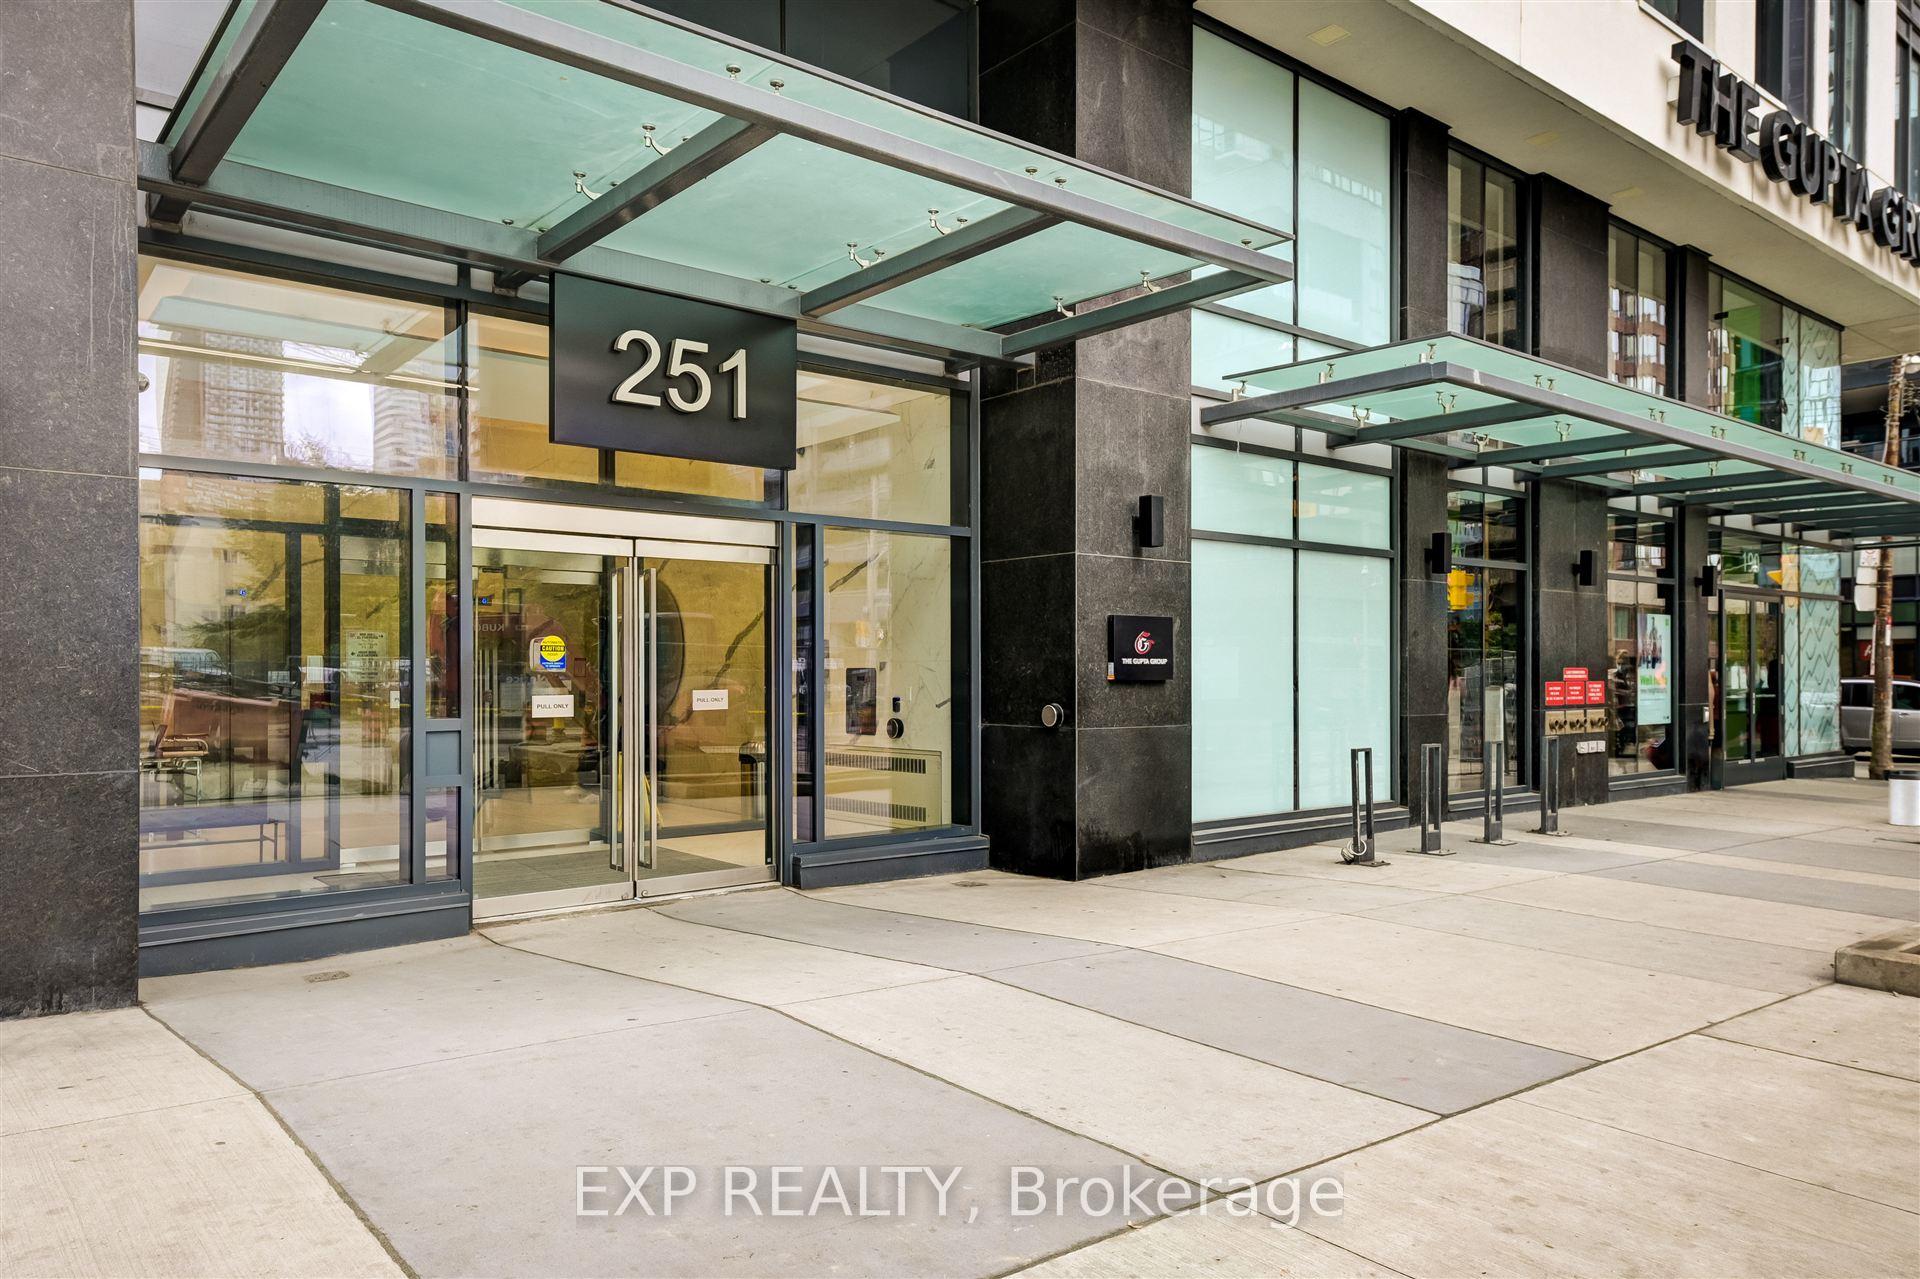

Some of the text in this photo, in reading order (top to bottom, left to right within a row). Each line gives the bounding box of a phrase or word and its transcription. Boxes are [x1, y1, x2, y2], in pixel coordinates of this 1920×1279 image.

[1671, 39, 1920, 268] THE GUPTA GR
[612, 329, 747, 419] 251
